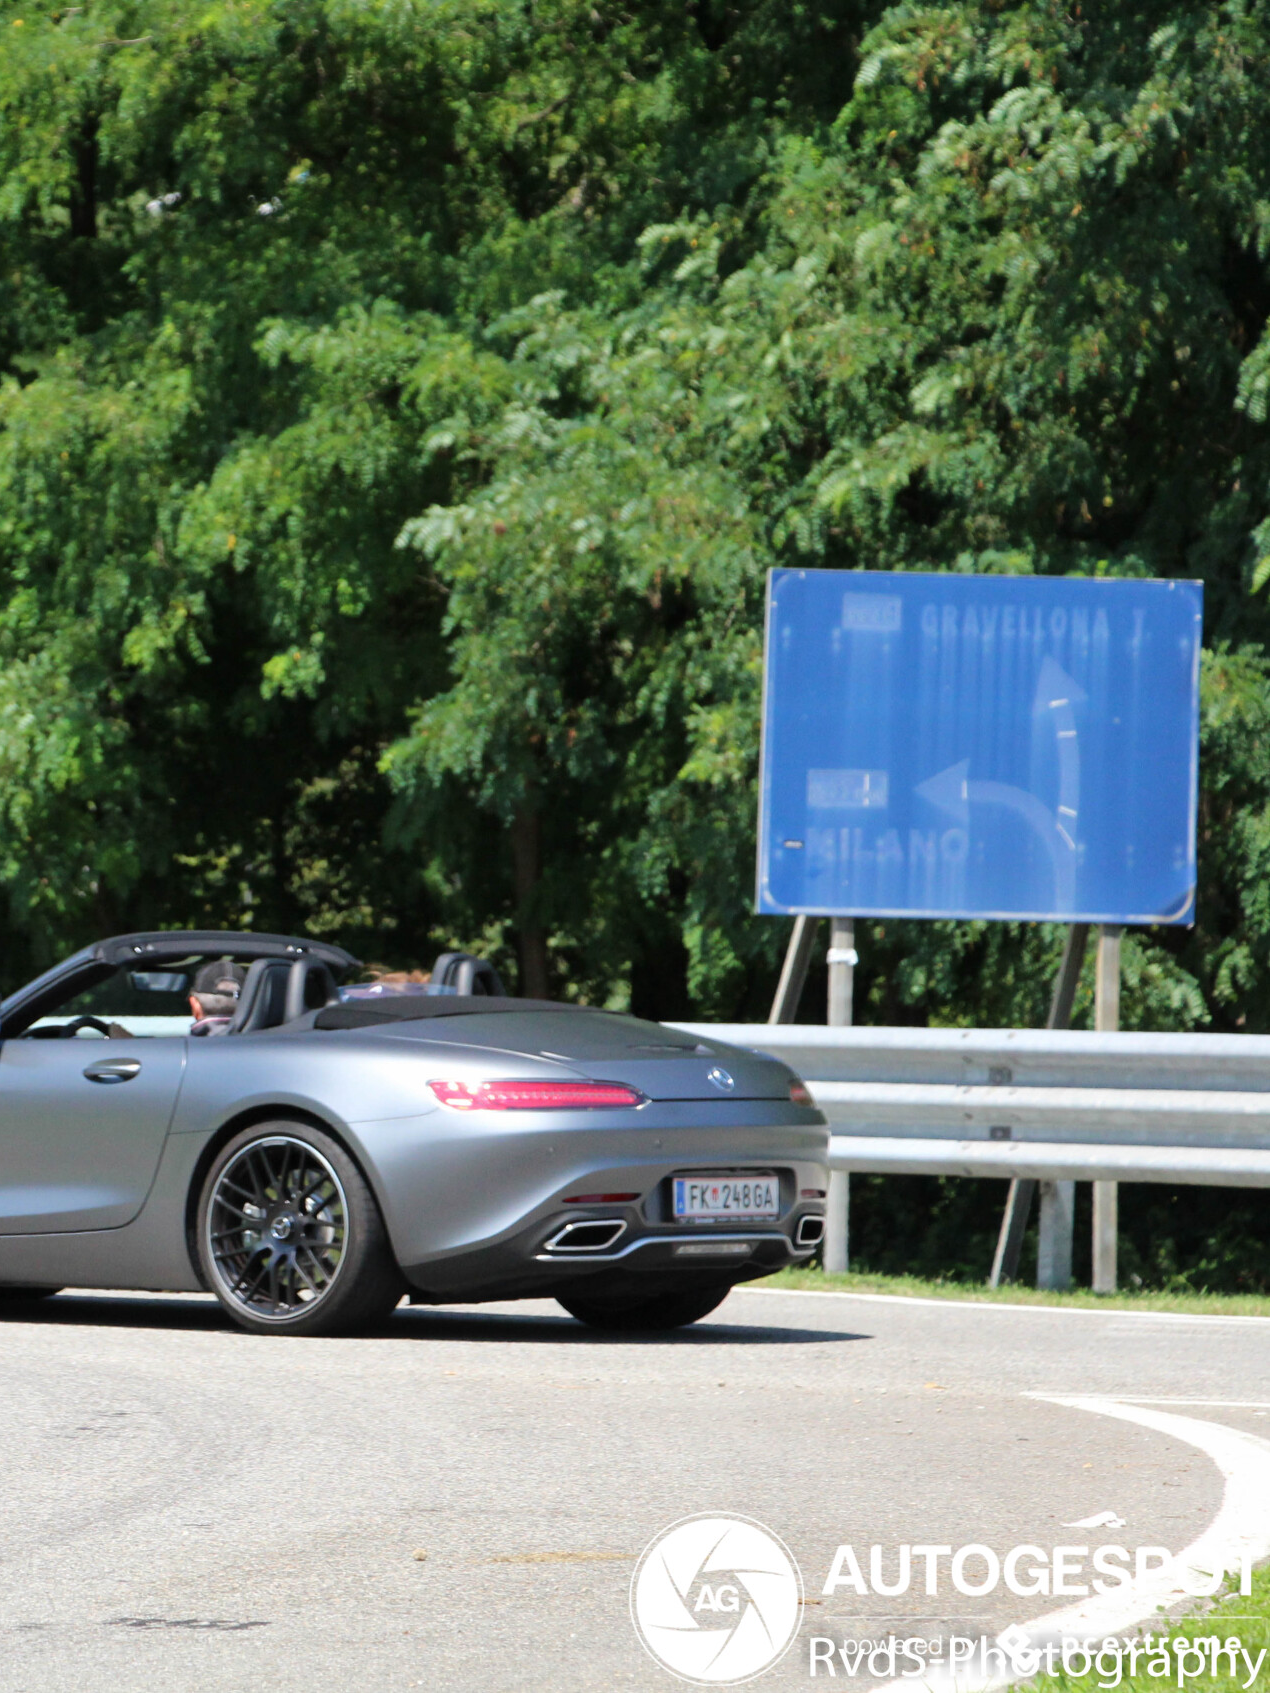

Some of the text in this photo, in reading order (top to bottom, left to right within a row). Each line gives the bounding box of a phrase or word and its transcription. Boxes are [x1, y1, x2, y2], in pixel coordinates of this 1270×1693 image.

[920, 602, 1110, 639] GRAVELLONA
[806, 827, 969, 863] MILANO
[689, 1184, 774, 1209] FK 248GA
